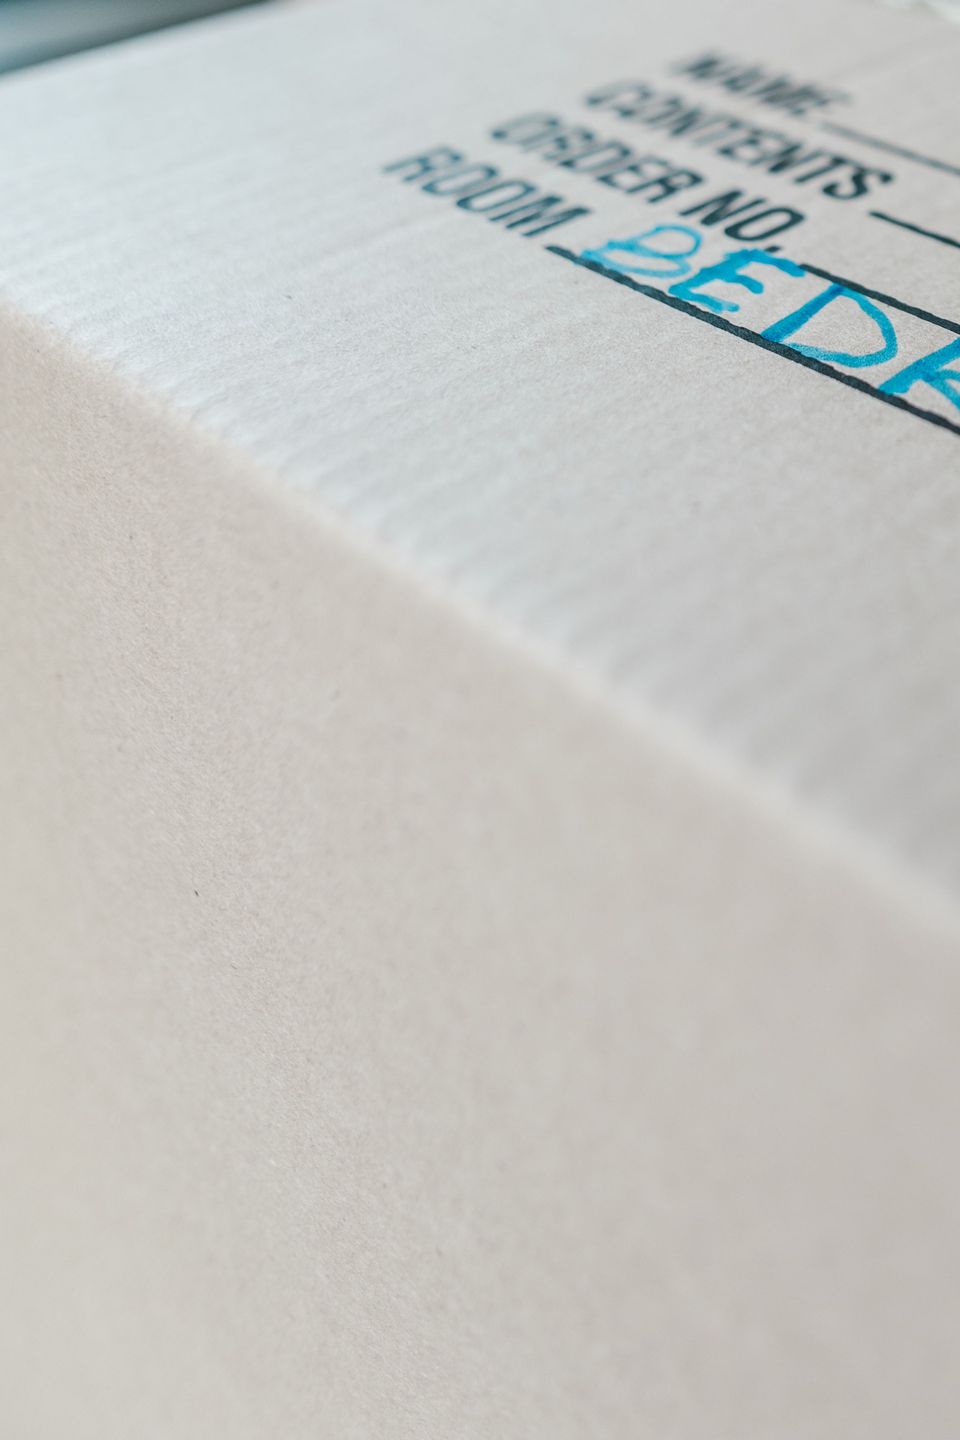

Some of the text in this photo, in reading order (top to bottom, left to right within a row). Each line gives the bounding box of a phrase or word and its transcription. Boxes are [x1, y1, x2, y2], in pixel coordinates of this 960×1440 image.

[383, 145, 594, 239] ROOM
[488, 111, 806, 255] ORDER NO.
[584, 78, 894, 202] CONTENTS
